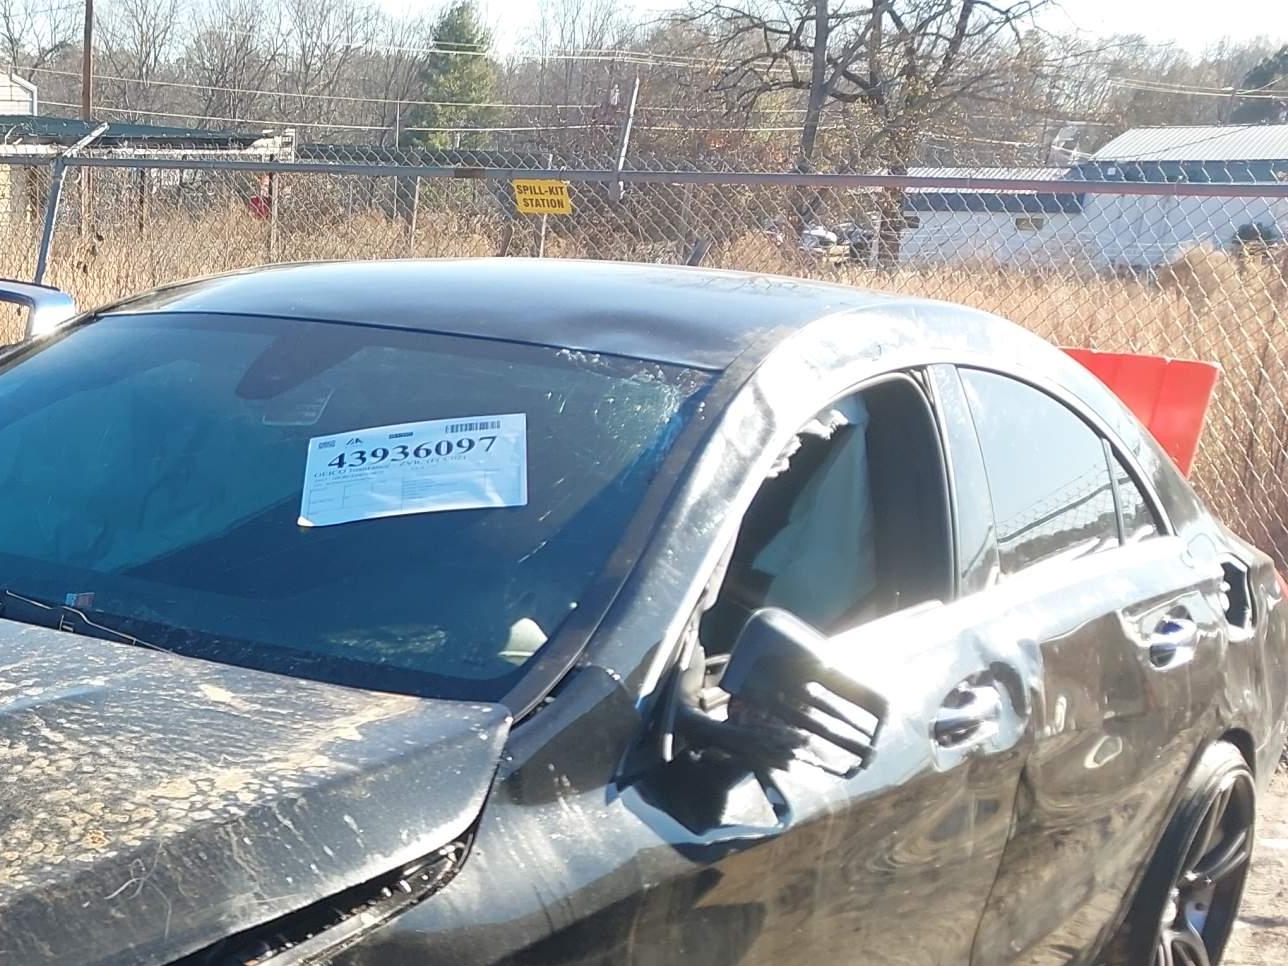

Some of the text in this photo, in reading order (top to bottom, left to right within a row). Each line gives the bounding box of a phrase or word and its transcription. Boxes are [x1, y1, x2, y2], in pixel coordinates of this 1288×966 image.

[516, 184, 564, 196] SPILL-KIT
[522, 197, 565, 209] STATION
[327, 435, 498, 469] 43936097
